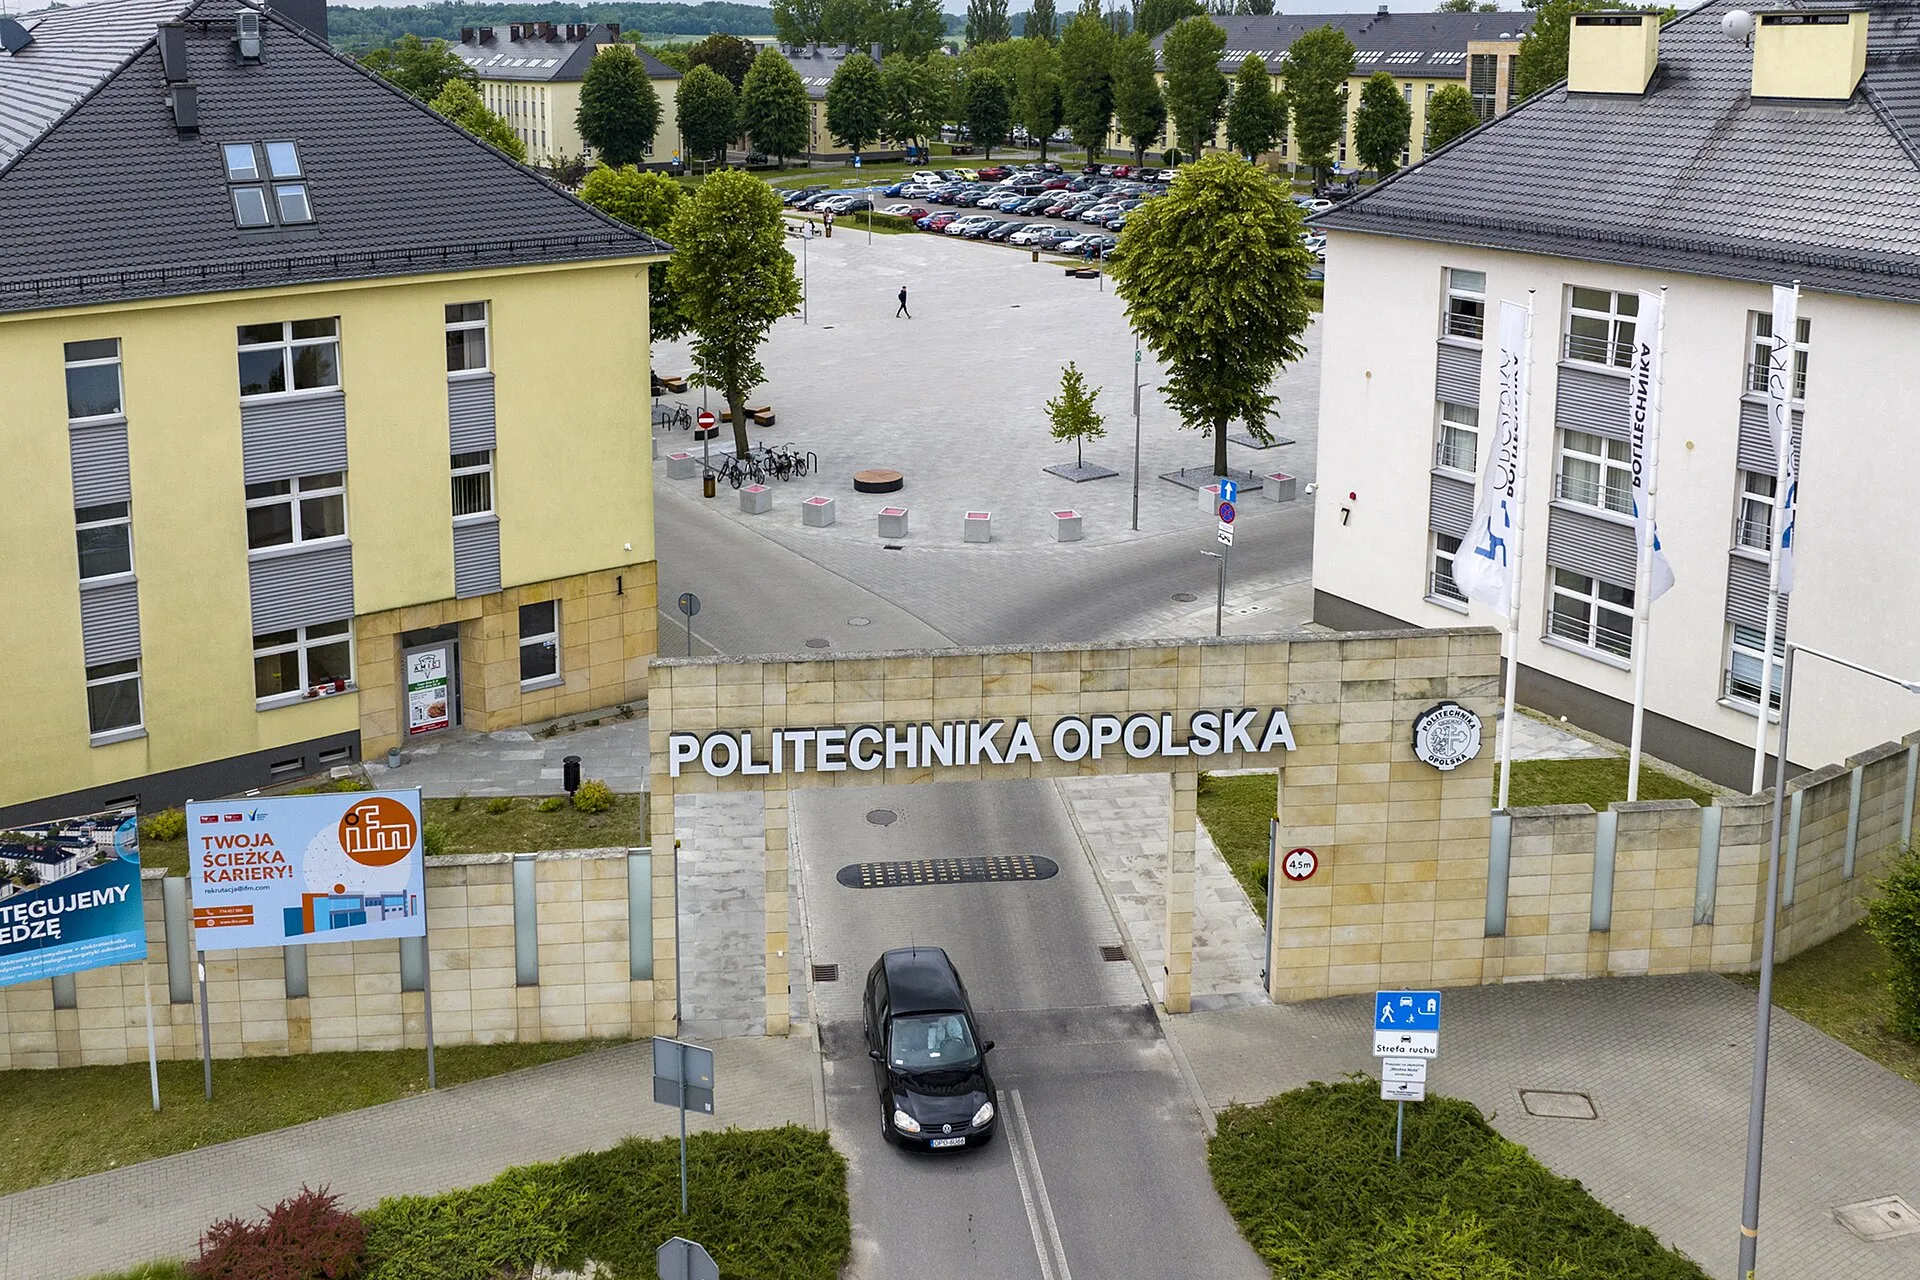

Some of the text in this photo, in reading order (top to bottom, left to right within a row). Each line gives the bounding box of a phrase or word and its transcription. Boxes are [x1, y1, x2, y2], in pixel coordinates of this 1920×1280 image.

[1341, 507, 1350, 526] 7
[616, 575, 624, 596] 1
[1422, 710, 1476, 732] POLITECHNIKA
[668, 708, 1297, 777] POLITECHNIKA OPOLSKA
[1428, 754, 1467, 766] OPOLSKA
[345, 805, 411, 853] ifm
[201, 833, 274, 850] TWOJA
[203, 848, 285, 868] ŚCIEŻKA
[203, 865, 293, 883] KARIERY!
[205, 885, 270, 895] rekrutacja@ifm.com
[1376, 1045, 1436, 1054] Strefa ruchu
